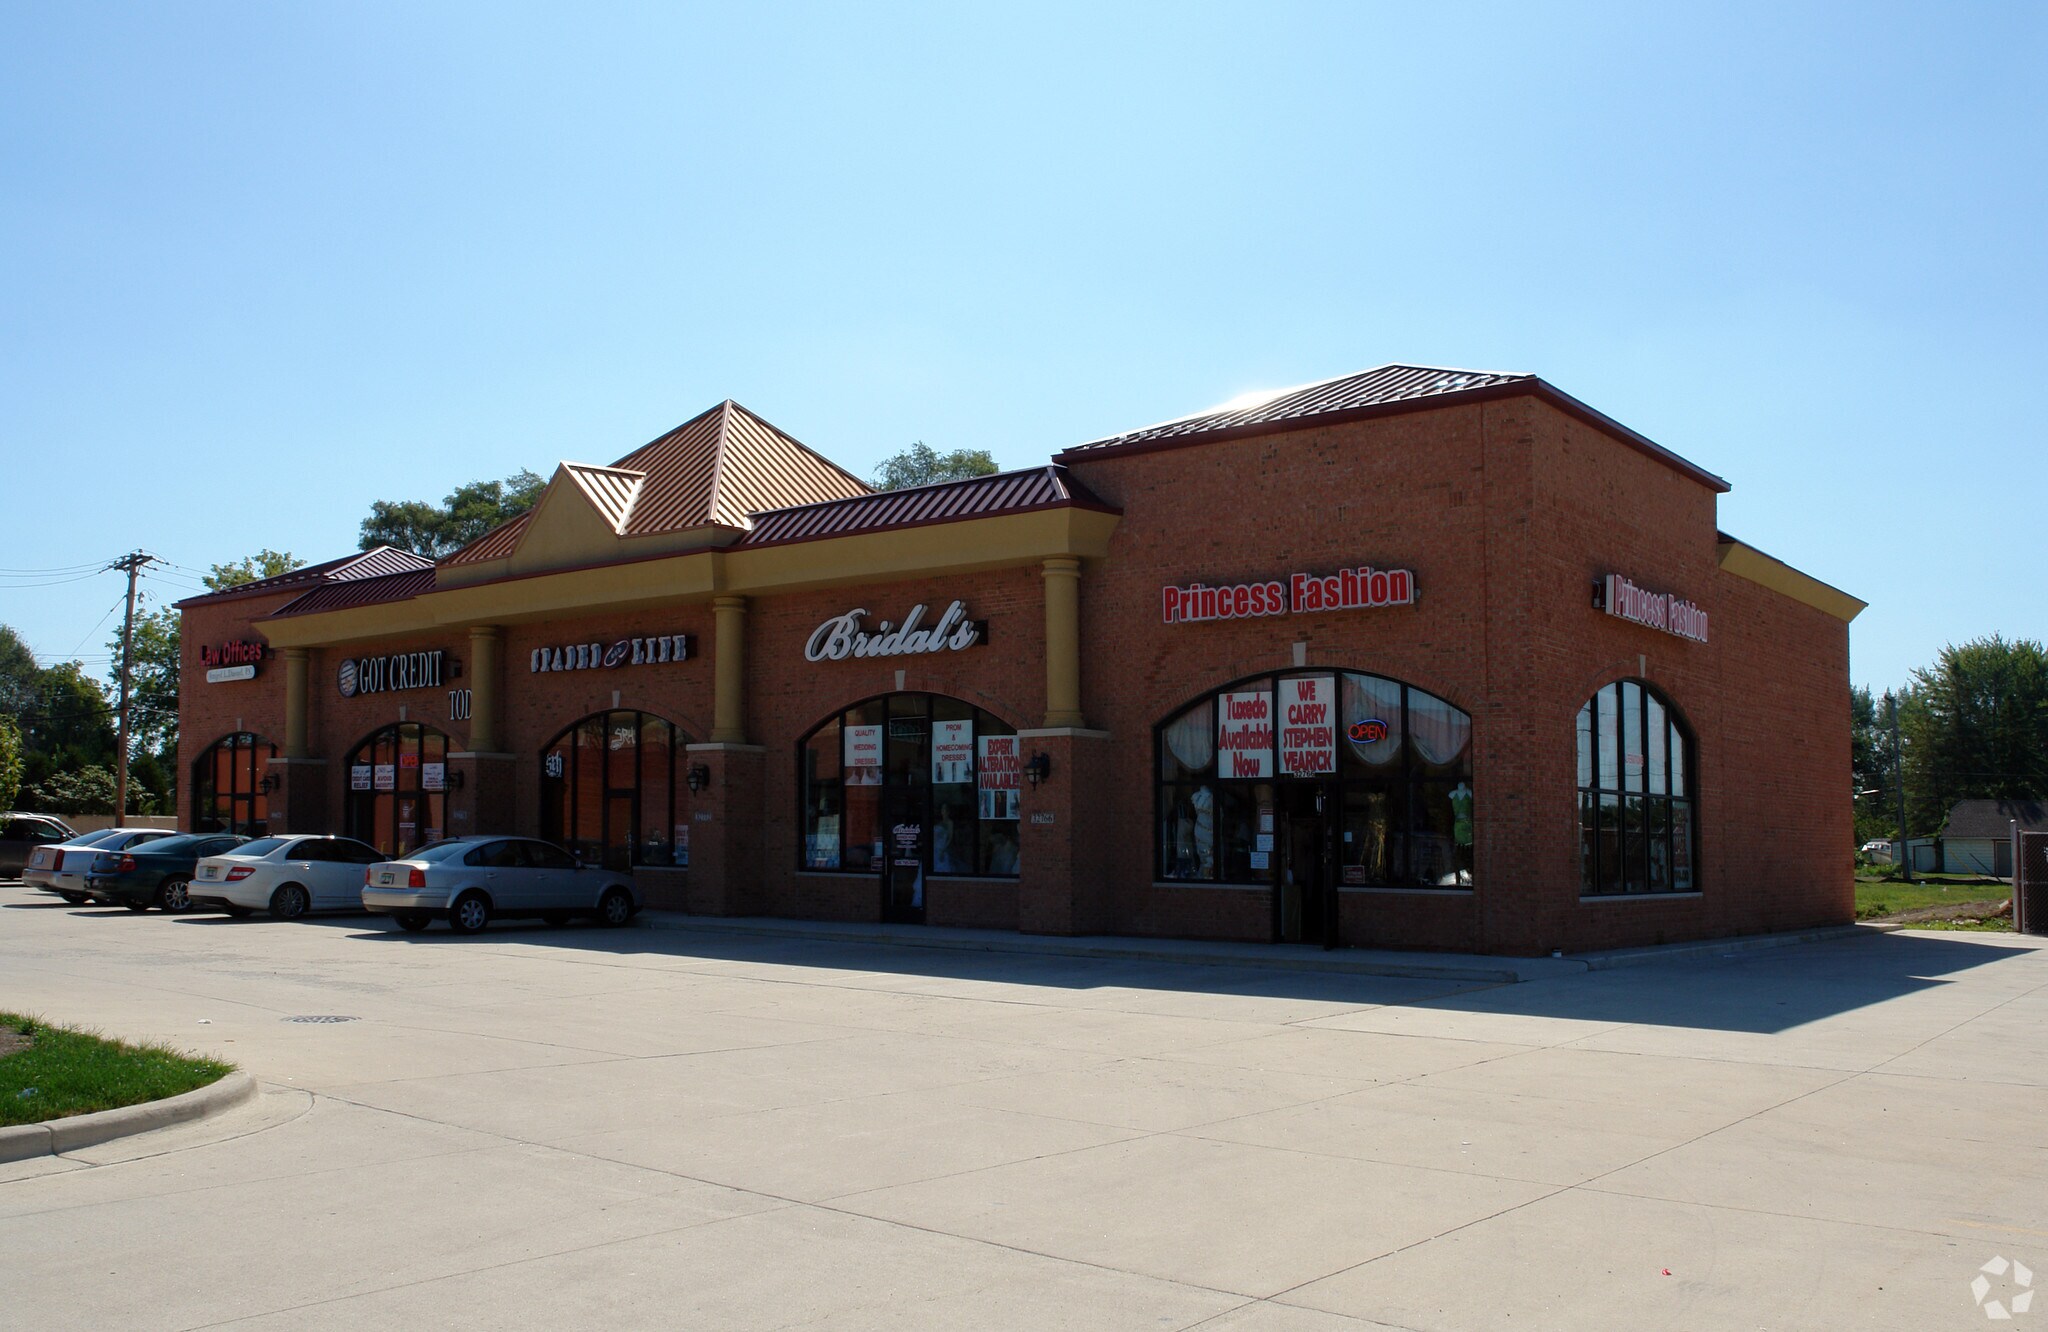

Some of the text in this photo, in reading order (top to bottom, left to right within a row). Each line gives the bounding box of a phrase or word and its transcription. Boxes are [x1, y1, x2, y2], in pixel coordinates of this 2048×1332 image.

[1163, 566, 1413, 623] Princess Fashion
[1614, 574, 1708, 643] Princess Fashion
[805, 600, 976, 661] Bridal's
[200, 640, 261, 666] Law Offices
[360, 650, 443, 694] GOT CREDIT
[1297, 680, 1316, 702] WE
[1226, 693, 1267, 721] Tuxedo
[1287, 703, 1327, 725] CARRY
[855, 729, 876, 737] QUALITY
[945, 723, 962, 732] PROM
[1218, 723, 1273, 751] Available
[1283, 727, 1333, 749] STEPHEN
[1347, 724, 1387, 741] OPEN
[854, 743, 877, 751] WEDDING
[936, 743, 975, 752] HOMECOMING
[942, 753, 967, 762] DRESSES
[987, 738, 1013, 756] EXPERT
[855, 757, 878, 765] DRESSES
[1232, 751, 1260, 777] Now
[1283, 750, 1333, 772] YEARICK
